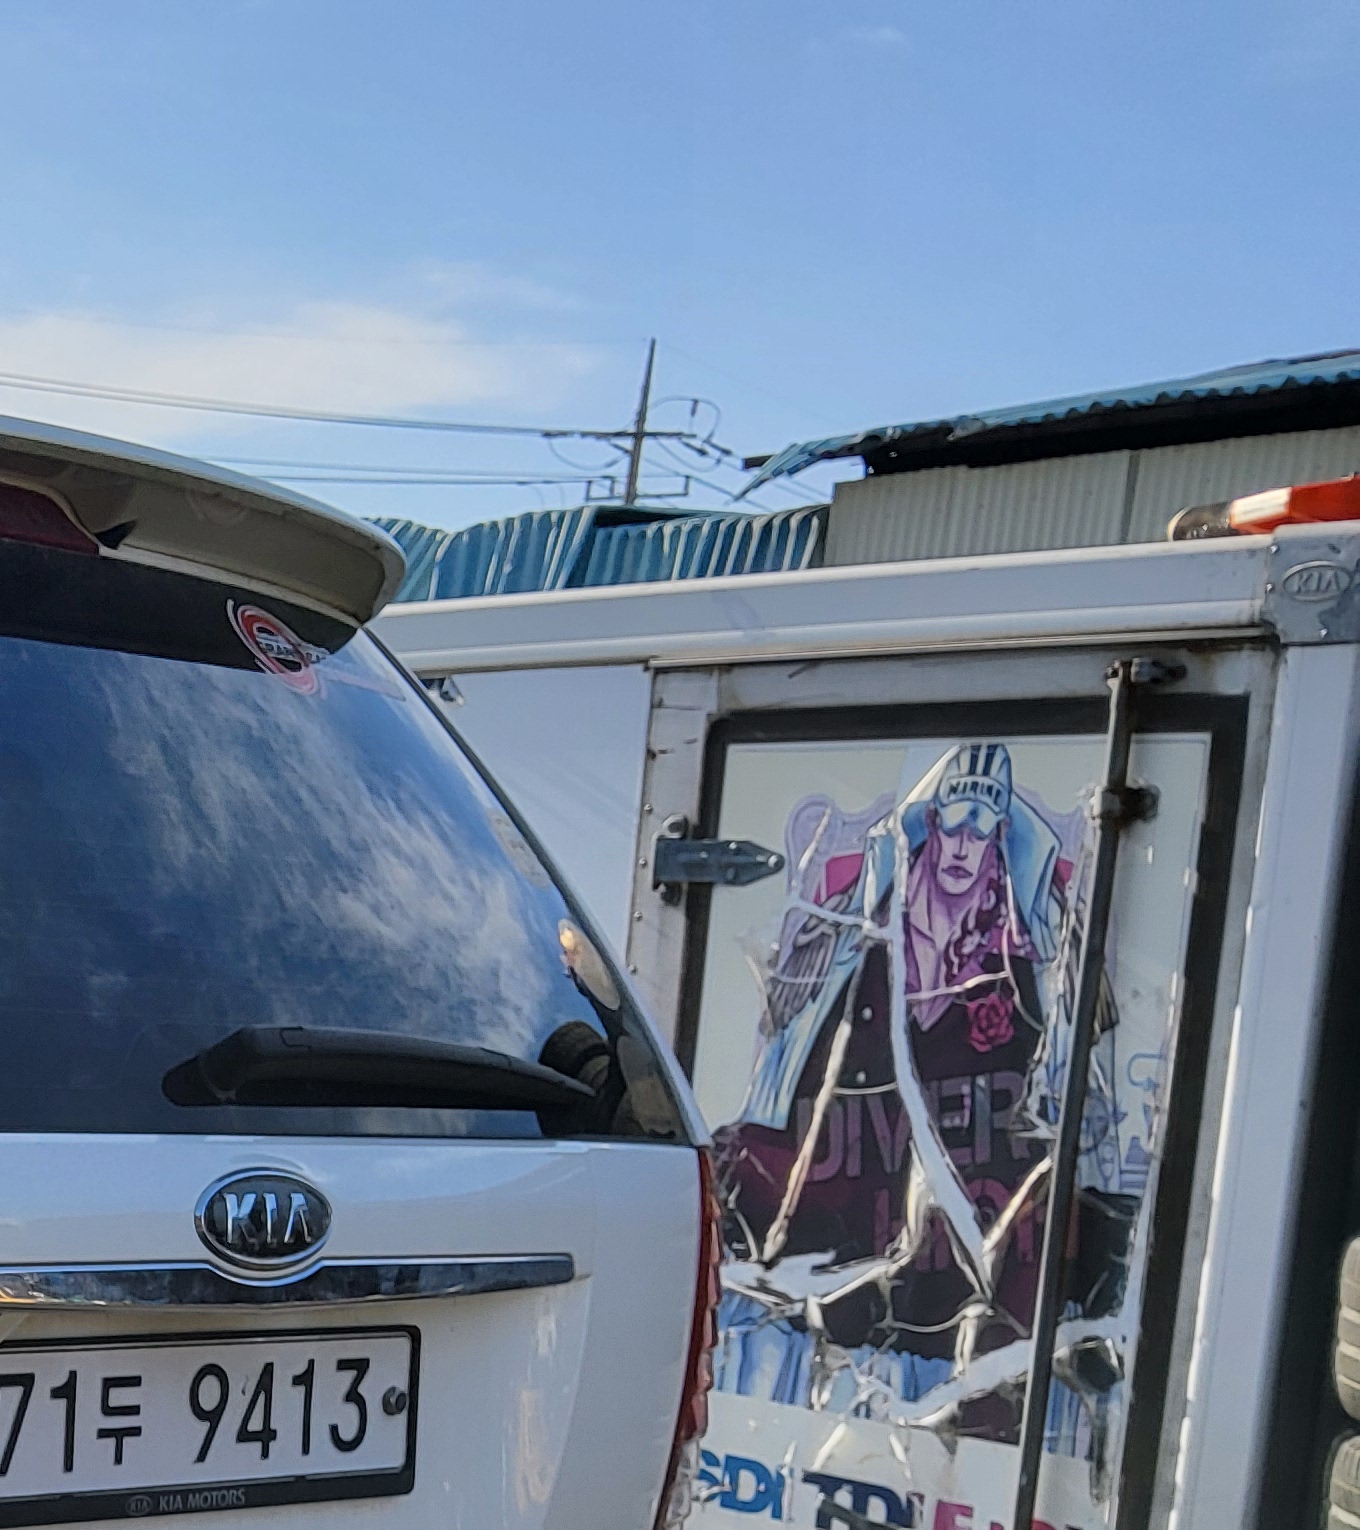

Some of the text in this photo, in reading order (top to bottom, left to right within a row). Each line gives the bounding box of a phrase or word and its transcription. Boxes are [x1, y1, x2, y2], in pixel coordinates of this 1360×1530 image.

[1293, 570, 1342, 594] KIA
[222, 1191, 314, 1245] KIA
[187, 1357, 371, 1464] 9413
[159, 1495, 183, 1512] KIA
[187, 1488, 246, 1510] MOTORS
